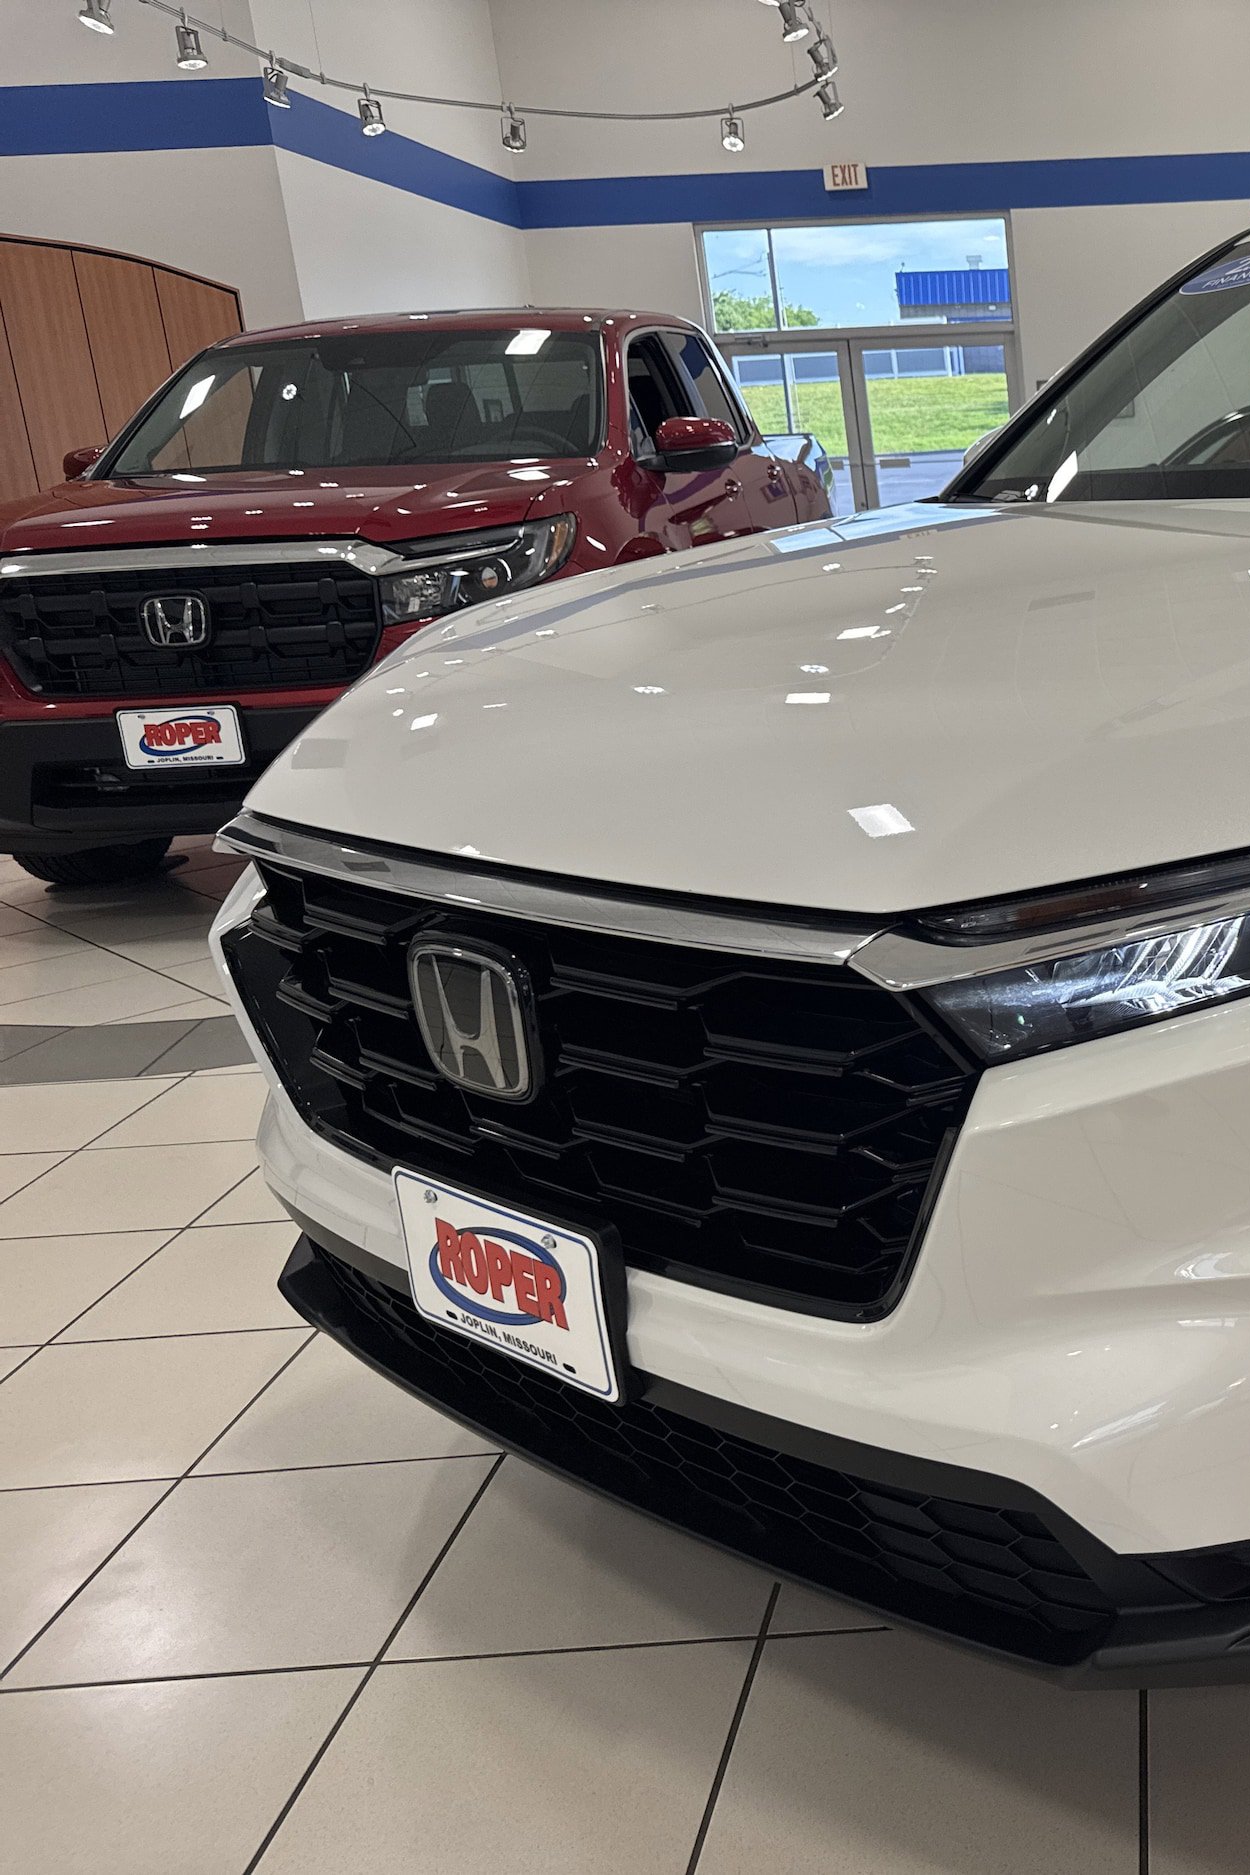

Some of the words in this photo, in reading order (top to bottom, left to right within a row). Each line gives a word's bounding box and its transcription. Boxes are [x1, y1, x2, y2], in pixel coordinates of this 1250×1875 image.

[831, 164, 859, 187] EXIT
[144, 722, 222, 746] ROPER
[434, 1216, 570, 1332] ROPER
[460, 1313, 502, 1342] JOPLIN,
[503, 1331, 558, 1366] MISSOURI
